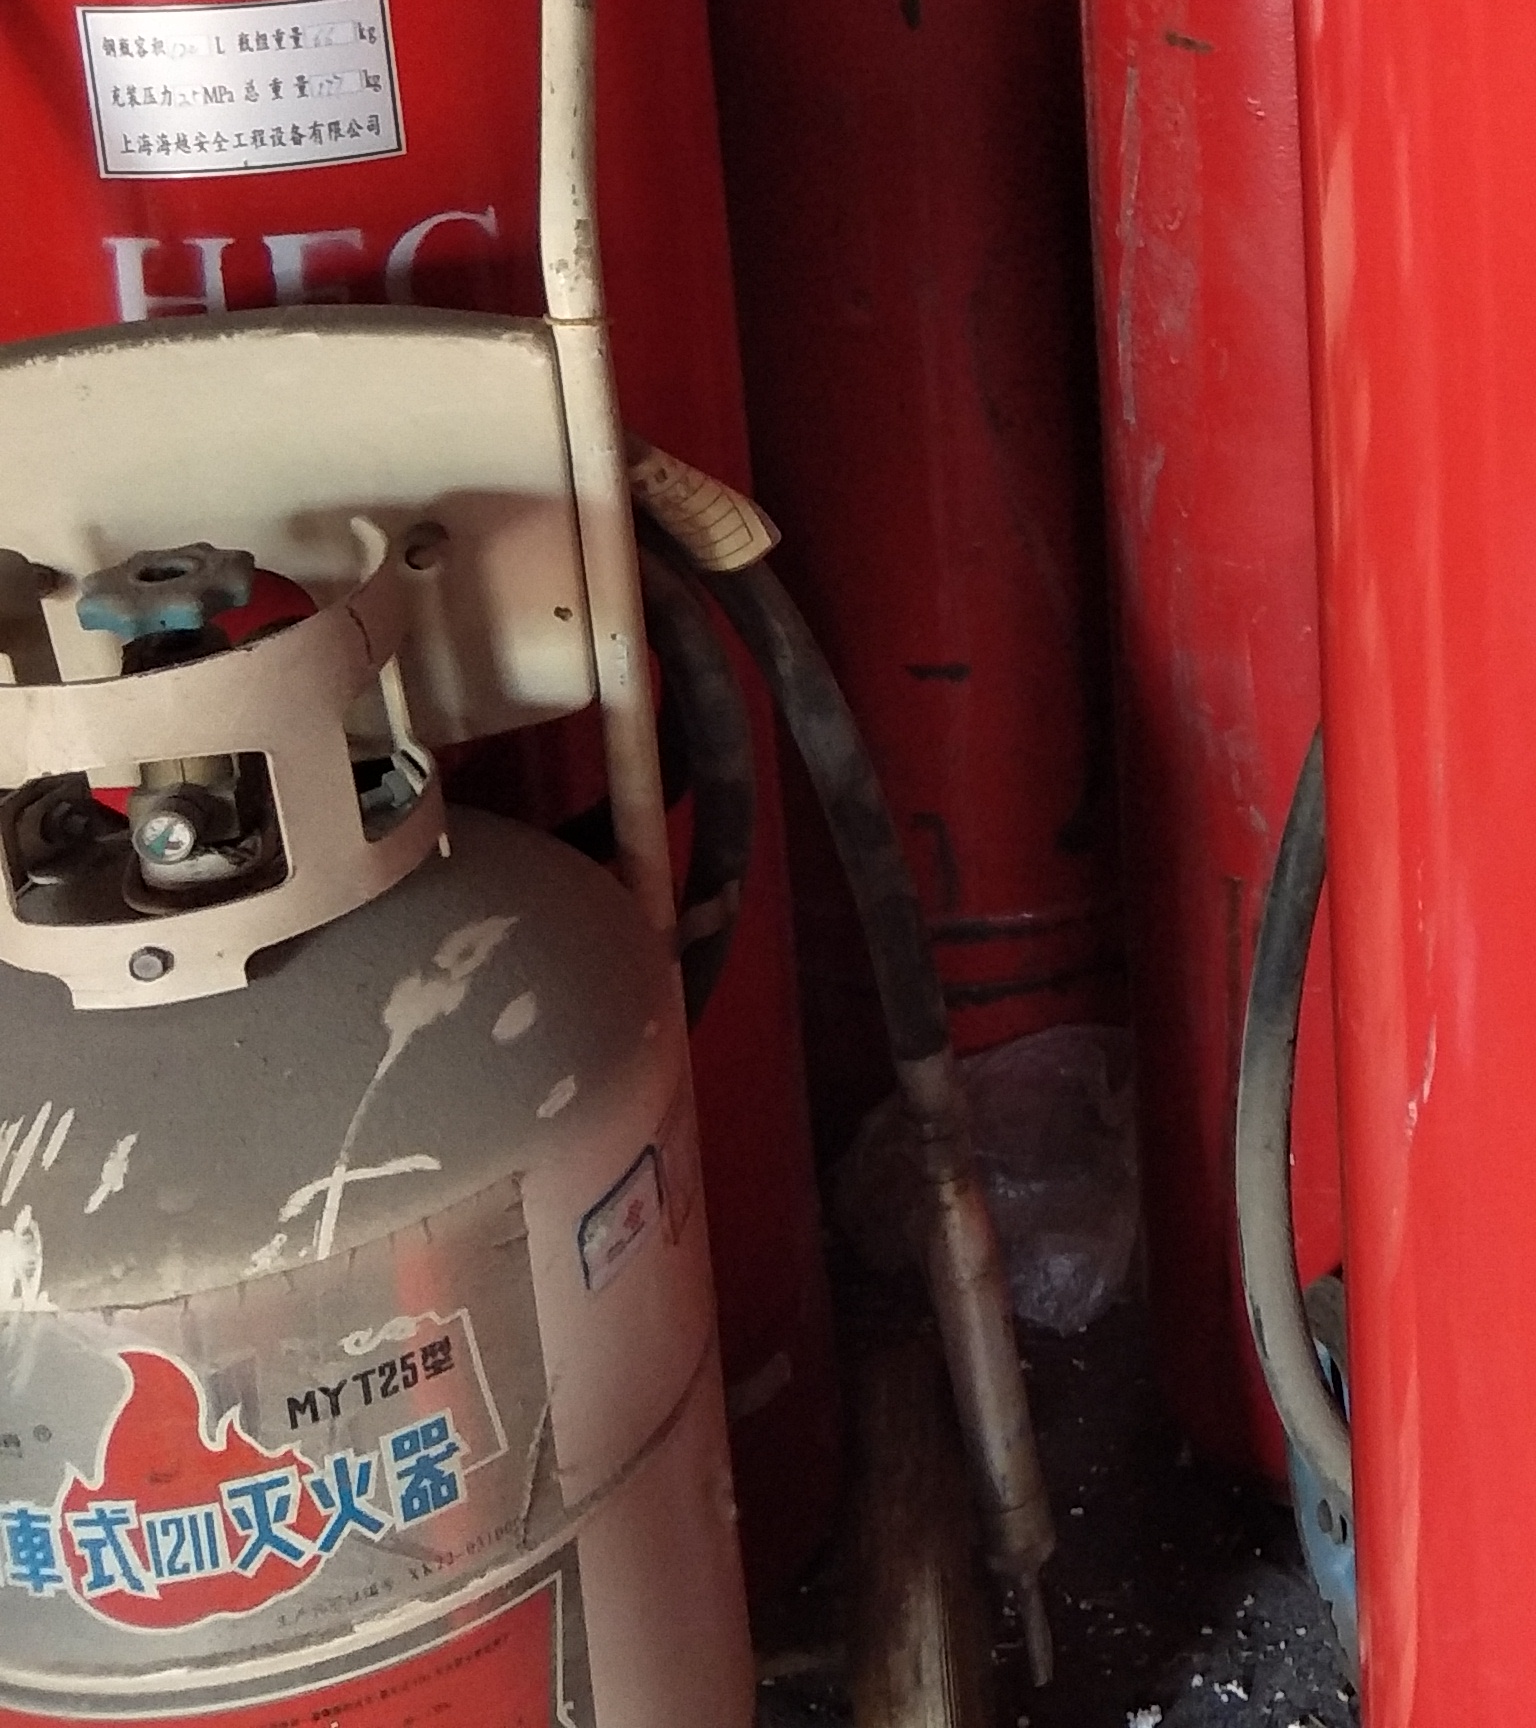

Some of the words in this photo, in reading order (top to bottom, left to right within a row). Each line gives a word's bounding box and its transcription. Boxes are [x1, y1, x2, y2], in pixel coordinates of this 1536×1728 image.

[357, 21, 378, 45] kg
[112, 84, 172, 108] 充装压力
[202, 84, 236, 105] MPa
[362, 69, 382, 93] kg
[120, 114, 381, 156] 上海海越安全工程设备有限公司
[286, 1335, 455, 1431] MYT25型
